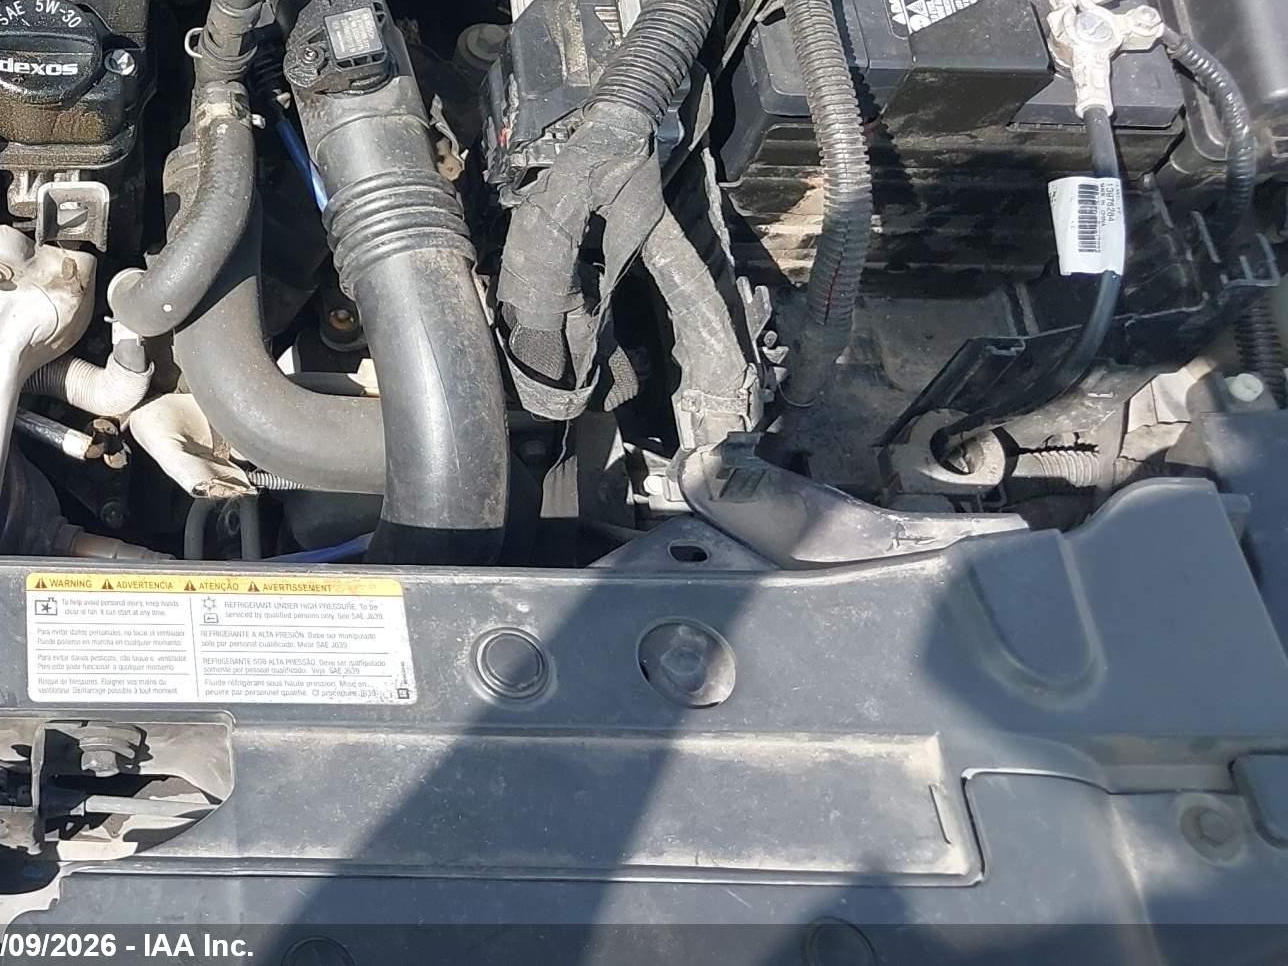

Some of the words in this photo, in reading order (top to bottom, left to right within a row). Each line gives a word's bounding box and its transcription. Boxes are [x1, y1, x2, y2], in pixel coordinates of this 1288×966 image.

[49, 579, 92, 587] WARNING
[117, 581, 173, 589] ADVERTENCIA
[199, 579, 239, 591] ATENÇÃO
[263, 584, 331, 592] AVERTISSEMENT
[224, 601, 271, 609] REFRIGERANT
[264, 612, 291, 620] qualified
[352, 612, 364, 620] SAE
[200, 630, 249, 638] REFRIGERANTE
